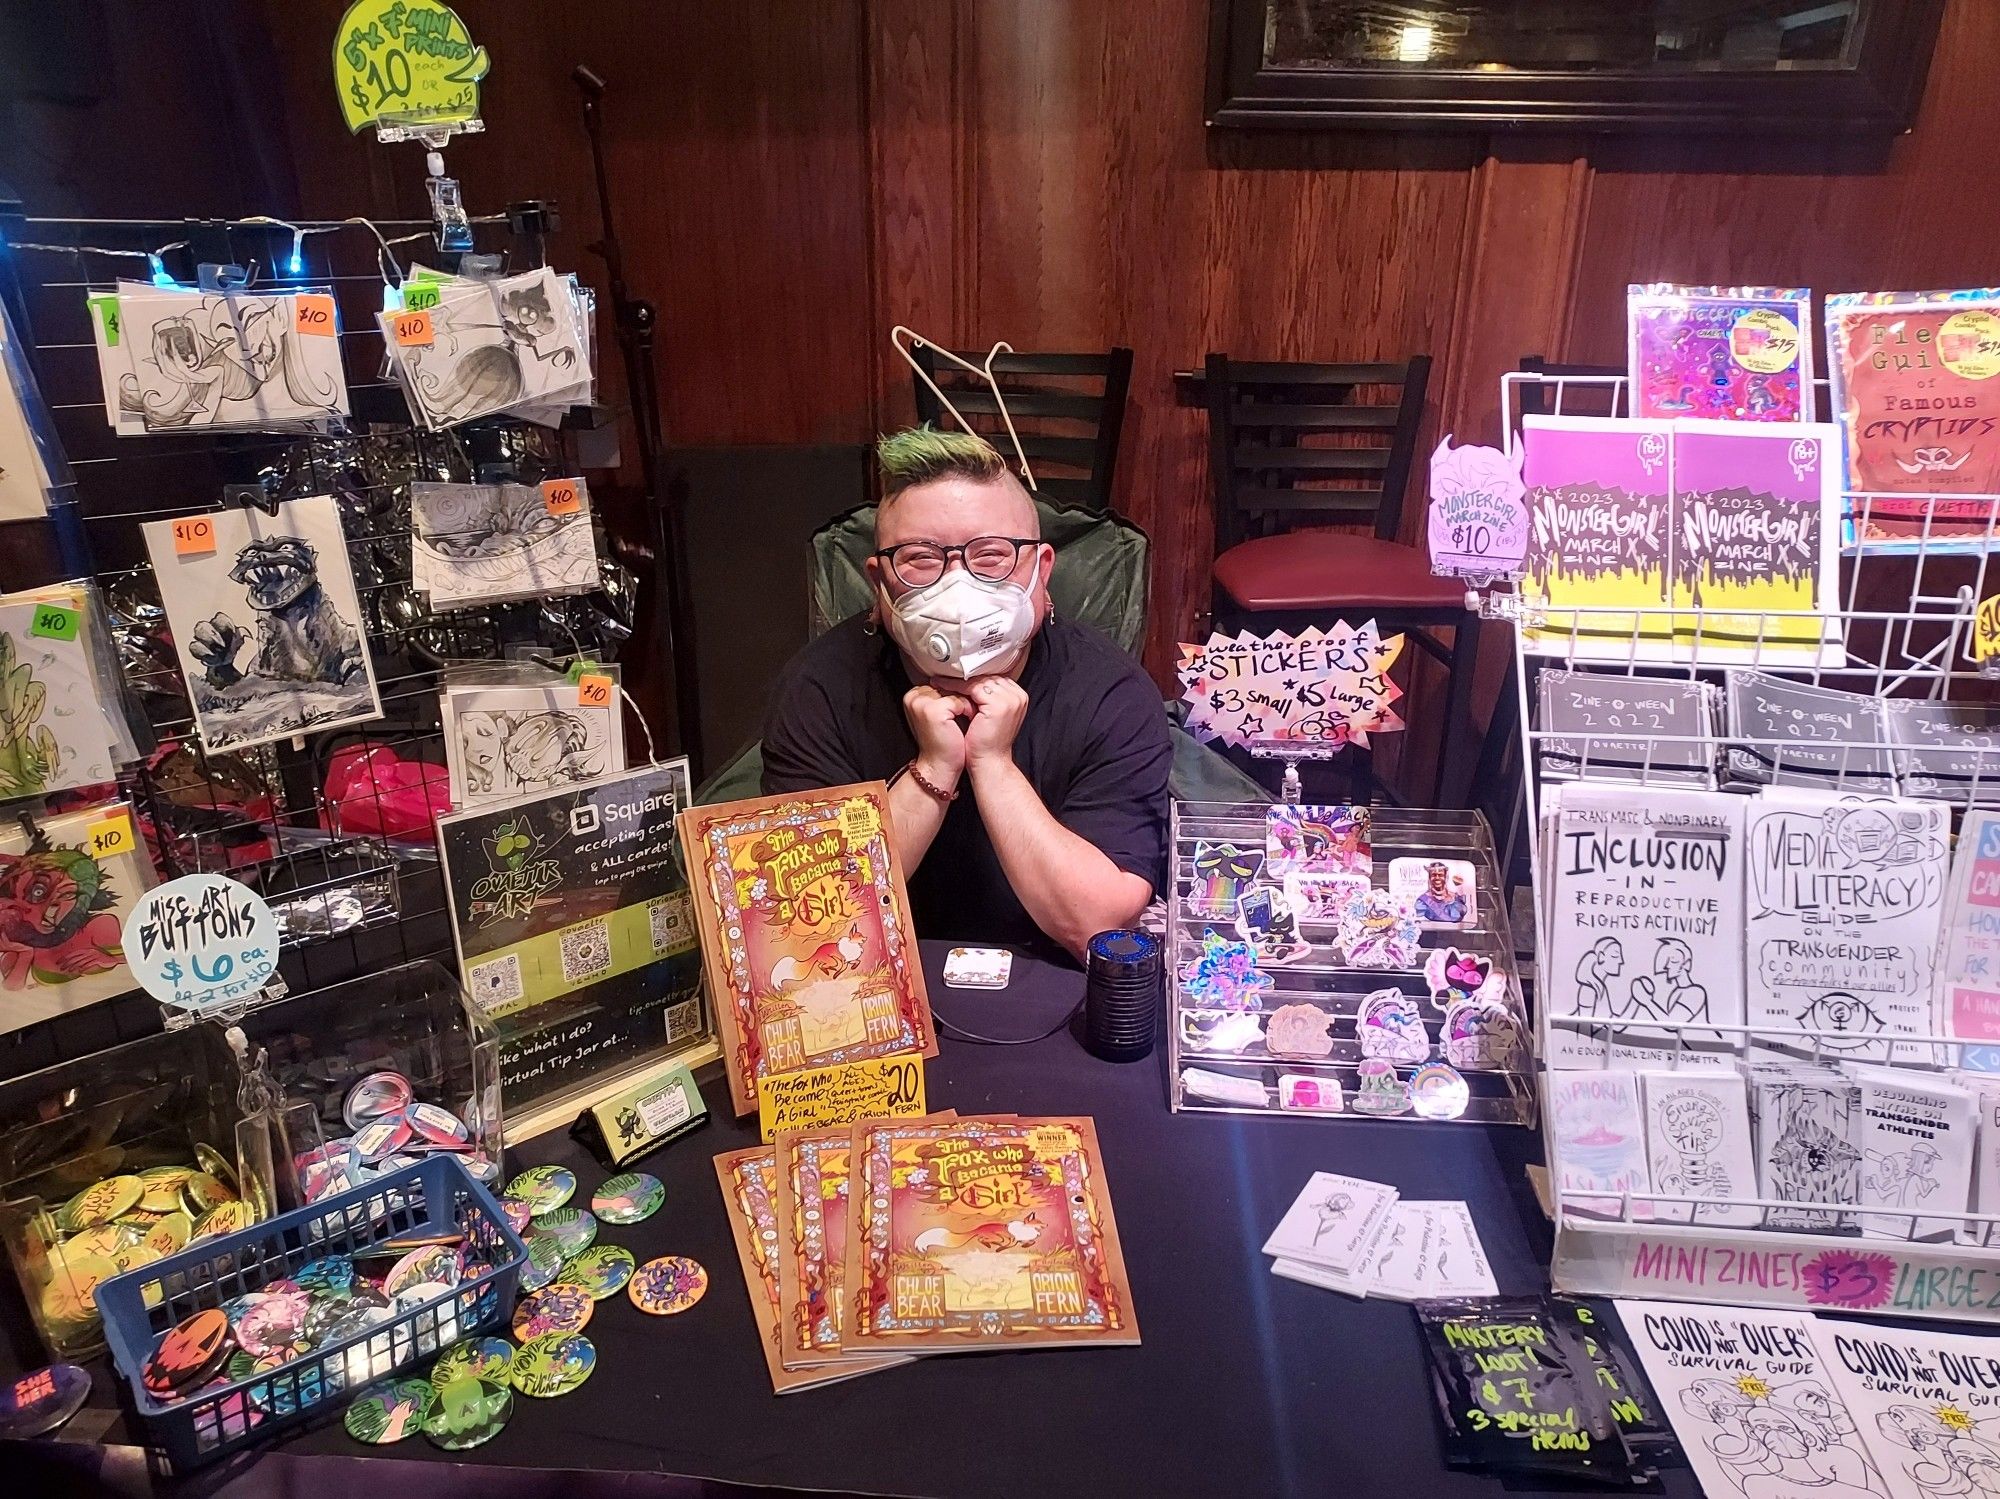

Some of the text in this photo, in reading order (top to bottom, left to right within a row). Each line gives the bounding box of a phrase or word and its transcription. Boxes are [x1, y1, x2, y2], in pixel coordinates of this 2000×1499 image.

[403, 32, 471, 60] PRINTS
[350, 48, 445, 116] $10 each
[409, 293, 437, 311] $10
[299, 308, 327, 324] $10
[399, 319, 425, 338] $10
[1872, 322, 1938, 345] Fie
[1765, 337, 1797, 353] $15
[1872, 350, 1938, 372] Gui
[1917, 378, 1936, 388] of
[1884, 396, 1977, 411] Famous
[1863, 416, 1998, 442] CRYPTIDS
[549, 488, 574, 507] $10
[1568, 493, 1614, 504] 2023
[1719, 498, 1765, 509] 2023
[1446, 509, 1481, 527] MARCH
[175, 521, 208, 541] $10
[1452, 525, 1490, 554] $10
[1564, 537, 1621, 555] MARCH
[1715, 544, 1772, 561] MARCH
[1563, 554, 1618, 565] ZINE
[1713, 561, 1769, 572] ZINE
[1209, 647, 1369, 680] STICKERS
[584, 684, 606, 702] $10
[1210, 689, 1245, 714] $3
[1297, 679, 1327, 708] $5
[1583, 713, 1664, 729] 2022
[1765, 719, 1841, 741] 2022
[604, 791, 676, 825] Square
[847, 811, 870, 822] WINNER
[1643, 809, 1653, 825] &
[1659, 814, 1727, 829] NONBINARY
[94, 829, 122, 850] $10
[574, 819, 675, 854] accepting cas
[766, 829, 795, 851] The
[590, 839, 672, 872] & ALL cards!
[1565, 826, 1726, 881] INCLUSION
[1765, 819, 1839, 907] MEDIA
[595, 877, 609, 886] tap
[620, 869, 635, 880] pay
[765, 836, 839, 898] Fox who
[201, 882, 232, 914] ART
[1576, 890, 1719, 912] REPRODUCTIVE
[1795, 872, 1917, 909] LITERACY
[493, 886, 538, 918] ART
[779, 880, 852, 927] a Girl
[140, 902, 256, 962] BUTTONS
[1576, 912, 1717, 936] RIGHTS ACTIVISM
[1804, 928, 1862, 939] ON THE
[1771, 939, 1902, 961] TRANSGENDER
[160, 954, 234, 988] $6
[1964, 954, 1989, 975] FOR
[222, 980, 249, 998] for
[863, 995, 894, 1018] ORION
[764, 1017, 799, 1046] CHLOE
[867, 1016, 900, 1045] FERN
[500, 1021, 593, 1067] ike what I do?
[548, 1054, 572, 1072] Tip
[576, 1043, 598, 1060] Jar
[603, 1032, 629, 1047] at...
[1561, 1046, 1575, 1055] AN
[1578, 1047, 1637, 1059] EDUCAIONAL
[1640, 1051, 1662, 1061] ZINE
[768, 1040, 804, 1073] BEAR
[790, 1075, 809, 1093] Fox
[811, 1073, 832, 1090] Who
[842, 1078, 865, 1088] AGES
[844, 1072, 860, 1080] ALL
[880, 1062, 918, 1107] $20
[1872, 1089, 1948, 1109] DEBUNKING
[1874, 1101, 1918, 1115] MYTHS
[775, 1109, 787, 1125] A
[846, 1109, 856, 1123] &
[860, 1109, 890, 1120] ORION
[895, 1100, 921, 1114] FERN
[1865, 1109, 1950, 1131] TRANSGENDER
[1037, 1134, 1067, 1142] WINNER
[1676, 1132, 1708, 1152] Tips
[1877, 1122, 1935, 1140] ATHLETES
[935, 1139, 969, 1153] The
[929, 1146, 1024, 1186] Fox who
[600, 1173, 641, 1196] MONSTER
[939, 1178, 1030, 1209] a Girl
[202, 1208, 237, 1232] They
[535, 1208, 580, 1226] MONSTER
[897, 1276, 941, 1296] CHLOE
[1033, 1272, 1076, 1293] ORION
[1632, 1242, 1709, 1285] MINI
[1717, 1249, 1803, 1292] ZINES
[1818, 1260, 1878, 1300] $3
[1893, 1262, 1988, 1311] LARGE
[897, 1295, 944, 1318] BEAR
[1035, 1291, 1081, 1315] FERN
[1444, 1323, 1547, 1348] MYSTERY
[1644, 1313, 1814, 1358] COVID IS NOT "OVER"
[1475, 1346, 1543, 1374] LOOT!
[1834, 1334, 1908, 1383] COVID
[1904, 1346, 1922, 1364] IS
[1766, 1361, 1814, 1375] GUIDE
[1911, 1367, 1939, 1384] NOT
[15, 1369, 52, 1396] SHE
[1482, 1377, 1536, 1409] $7
[1744, 1382, 1764, 1393] FREE
[1467, 1407, 1576, 1431] 3 special
[1944, 1412, 1967, 1424] FREE
[1531, 1429, 1590, 1451] items
